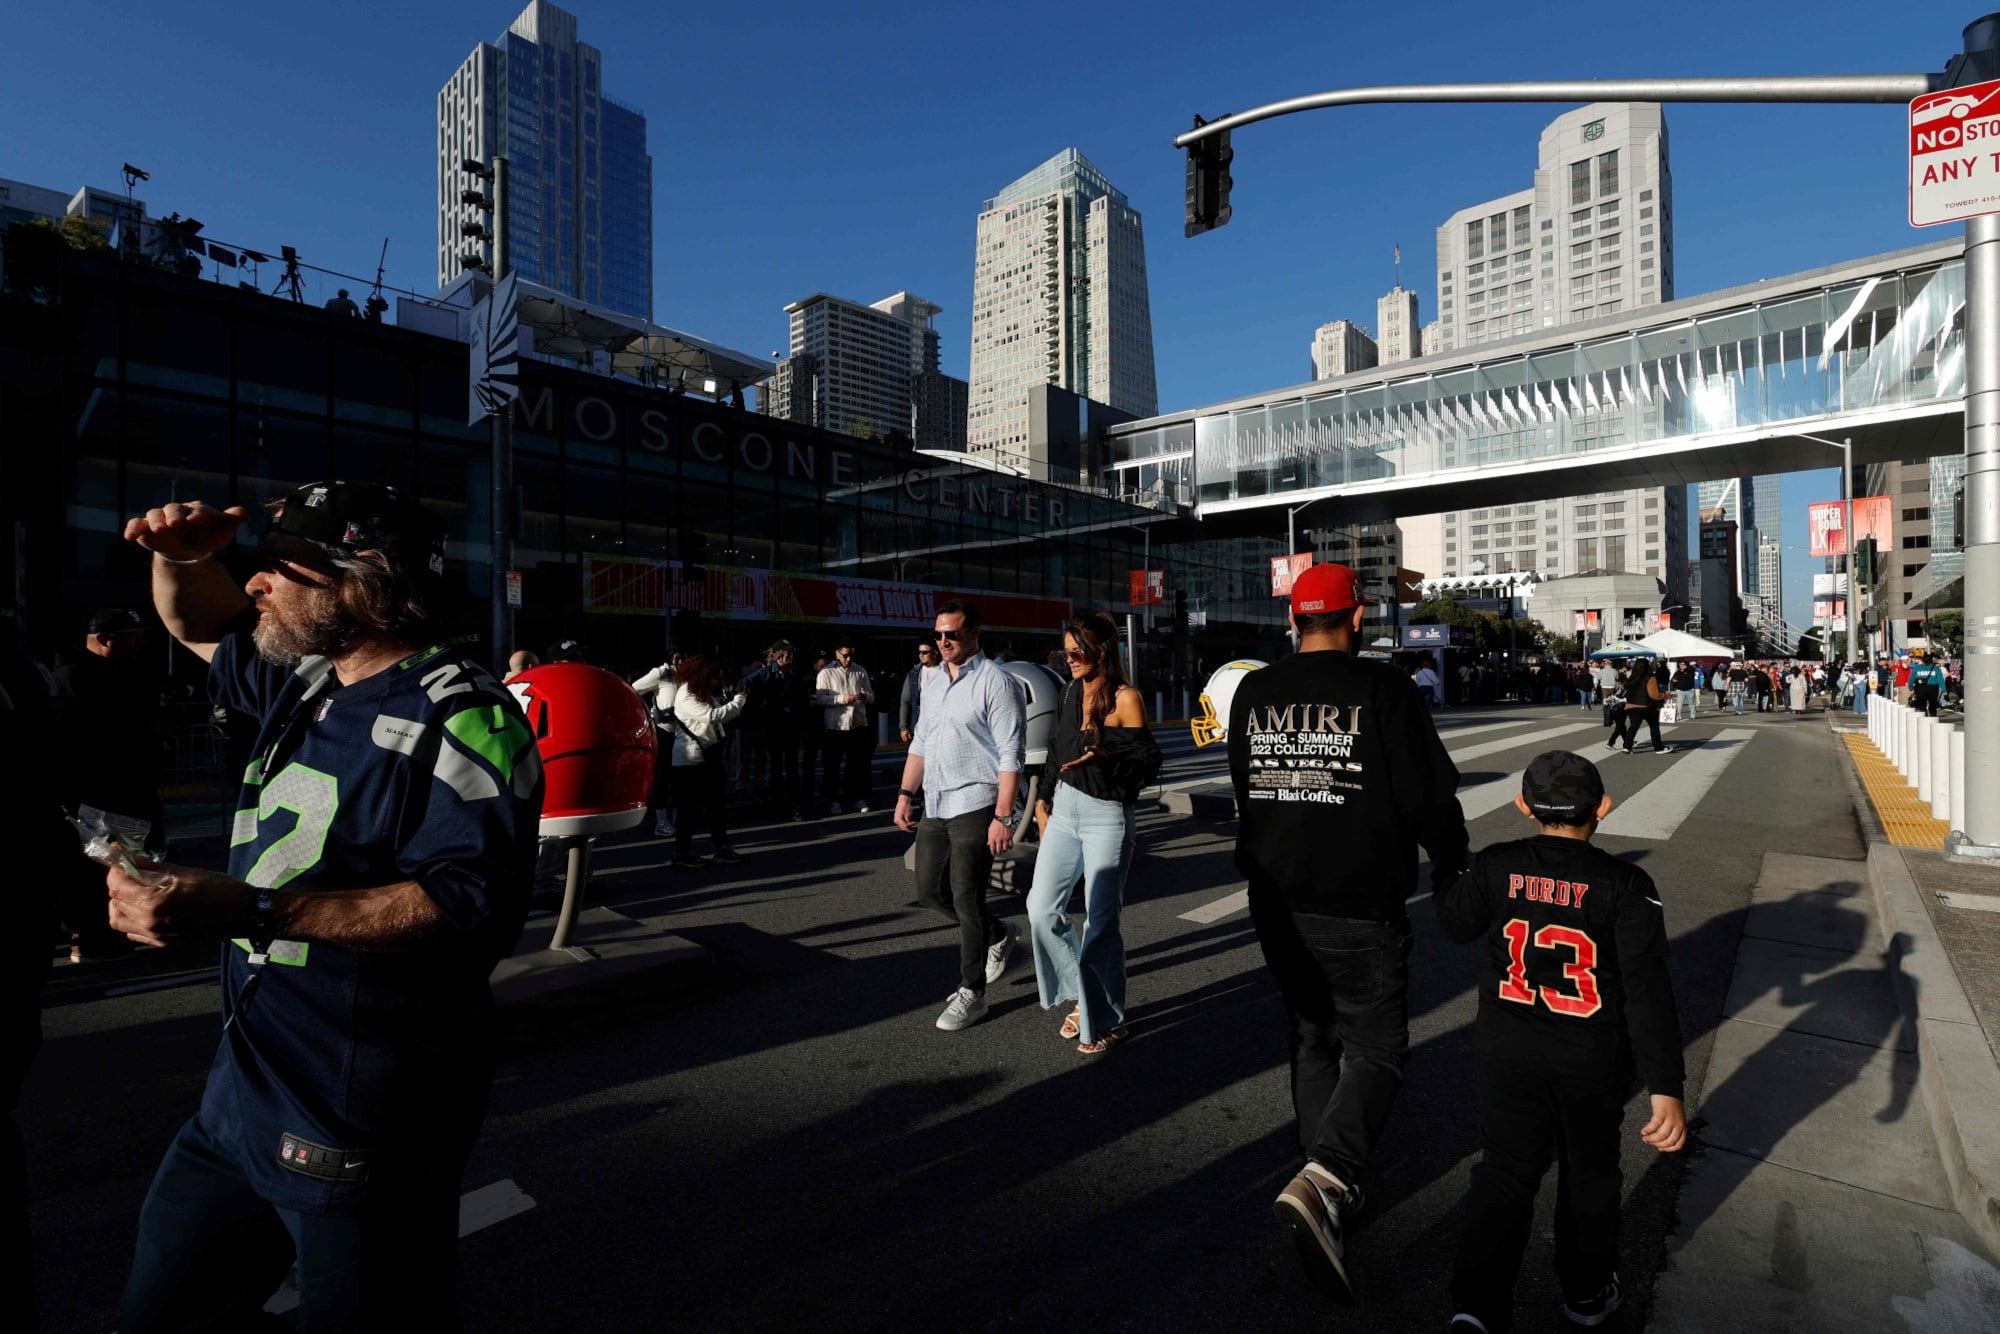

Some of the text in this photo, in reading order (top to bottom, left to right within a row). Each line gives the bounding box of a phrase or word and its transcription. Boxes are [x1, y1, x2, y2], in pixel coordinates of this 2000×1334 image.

[1916, 126, 1961, 151] NO
[1921, 156, 1978, 187] ANY
[1945, 194, 2000, 209] TOWED? 415-
[512, 386, 1066, 528] MOSCONE CENTER
[1811, 508, 1841, 521] SUPER
[1817, 519, 1844, 531] BOWL
[836, 586, 881, 615] SUPER
[882, 589, 918, 618] BOWL
[1246, 703, 1362, 735] AMIRI
[1250, 733, 1288, 745] PRING
[1297, 732, 1354, 746] SUMMER
[1250, 744, 1351, 757] 022 COLLECTION
[1284, 758, 1363, 773] VEGAS
[1300, 789, 1345, 805] Coffee
[1508, 873, 1590, 909] PURDY
[1498, 917, 1603, 1019] 13
